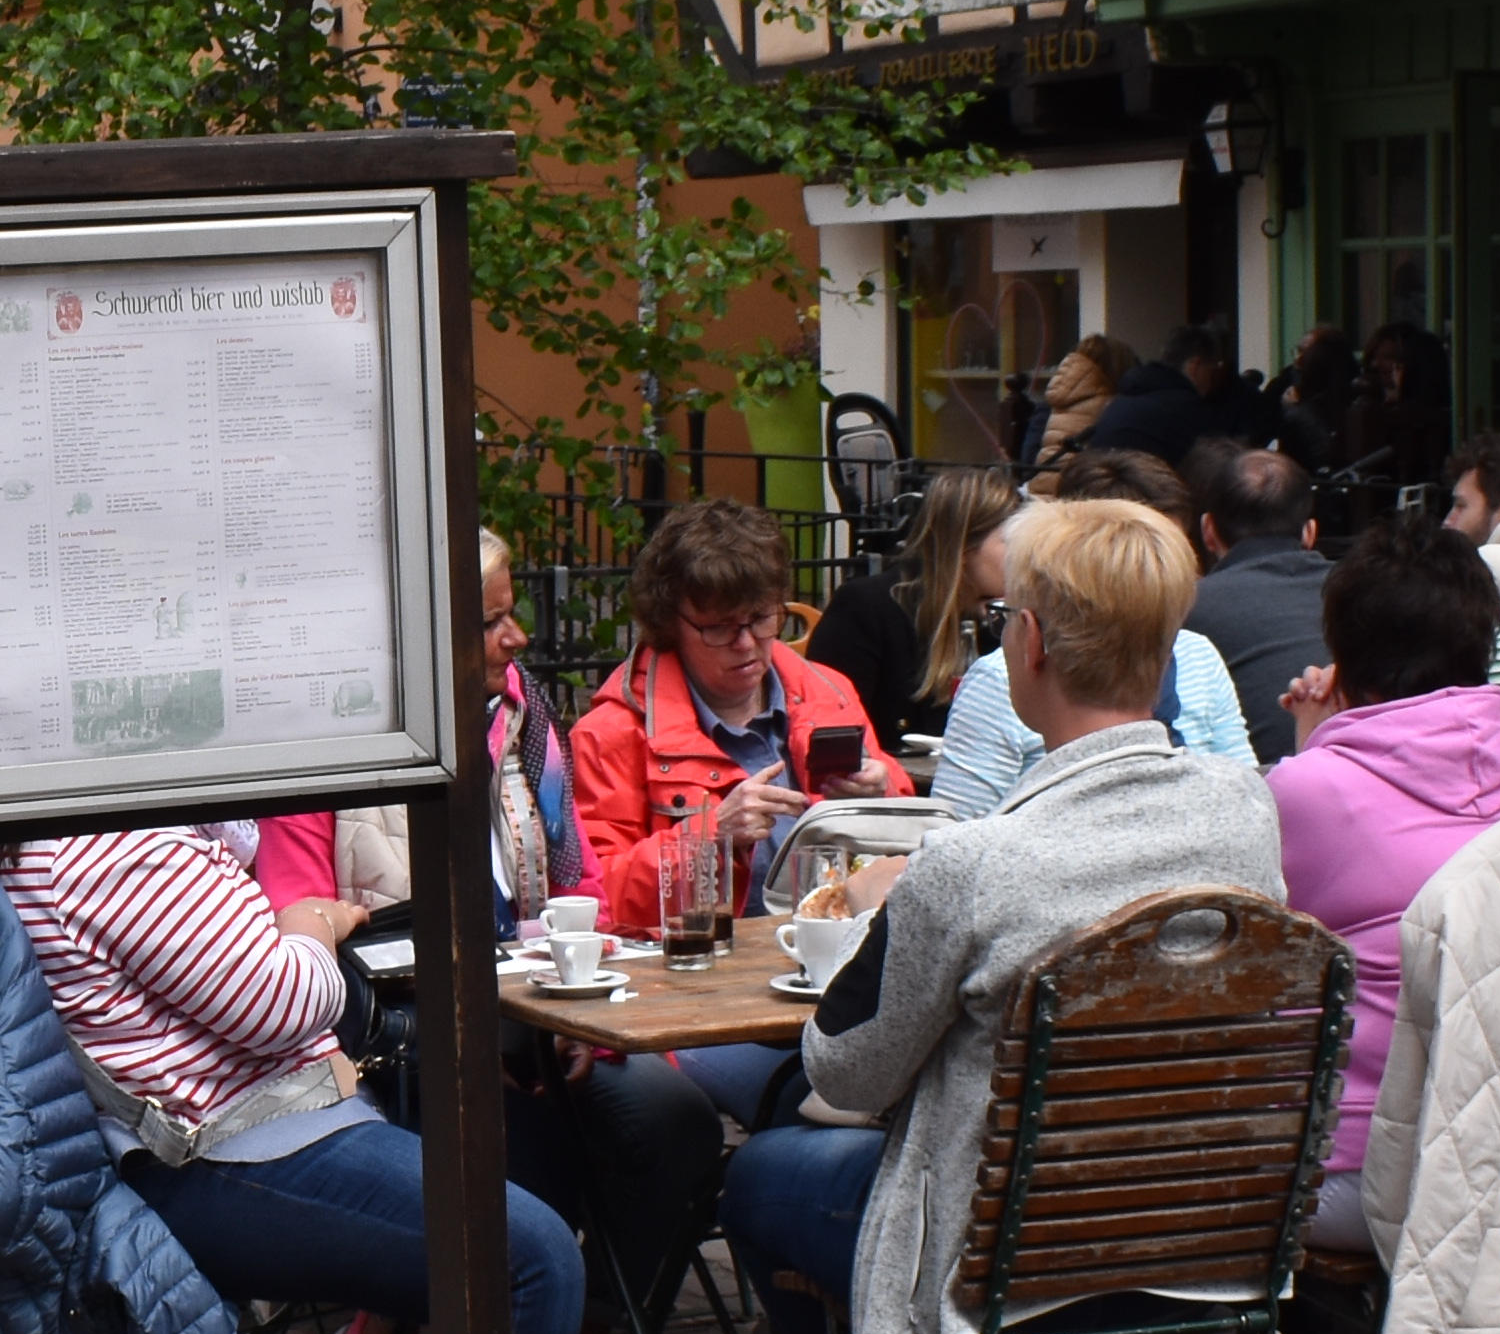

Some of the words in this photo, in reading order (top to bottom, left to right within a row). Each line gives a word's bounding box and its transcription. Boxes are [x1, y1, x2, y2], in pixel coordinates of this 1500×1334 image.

[1023, 29, 1098, 75] HELD
[92, 283, 184, 318] Schwendi
[190, 287, 224, 312] bier
[232, 285, 263, 310] und
[270, 279, 324, 307] wistub
[662, 858, 673, 898] COLA
